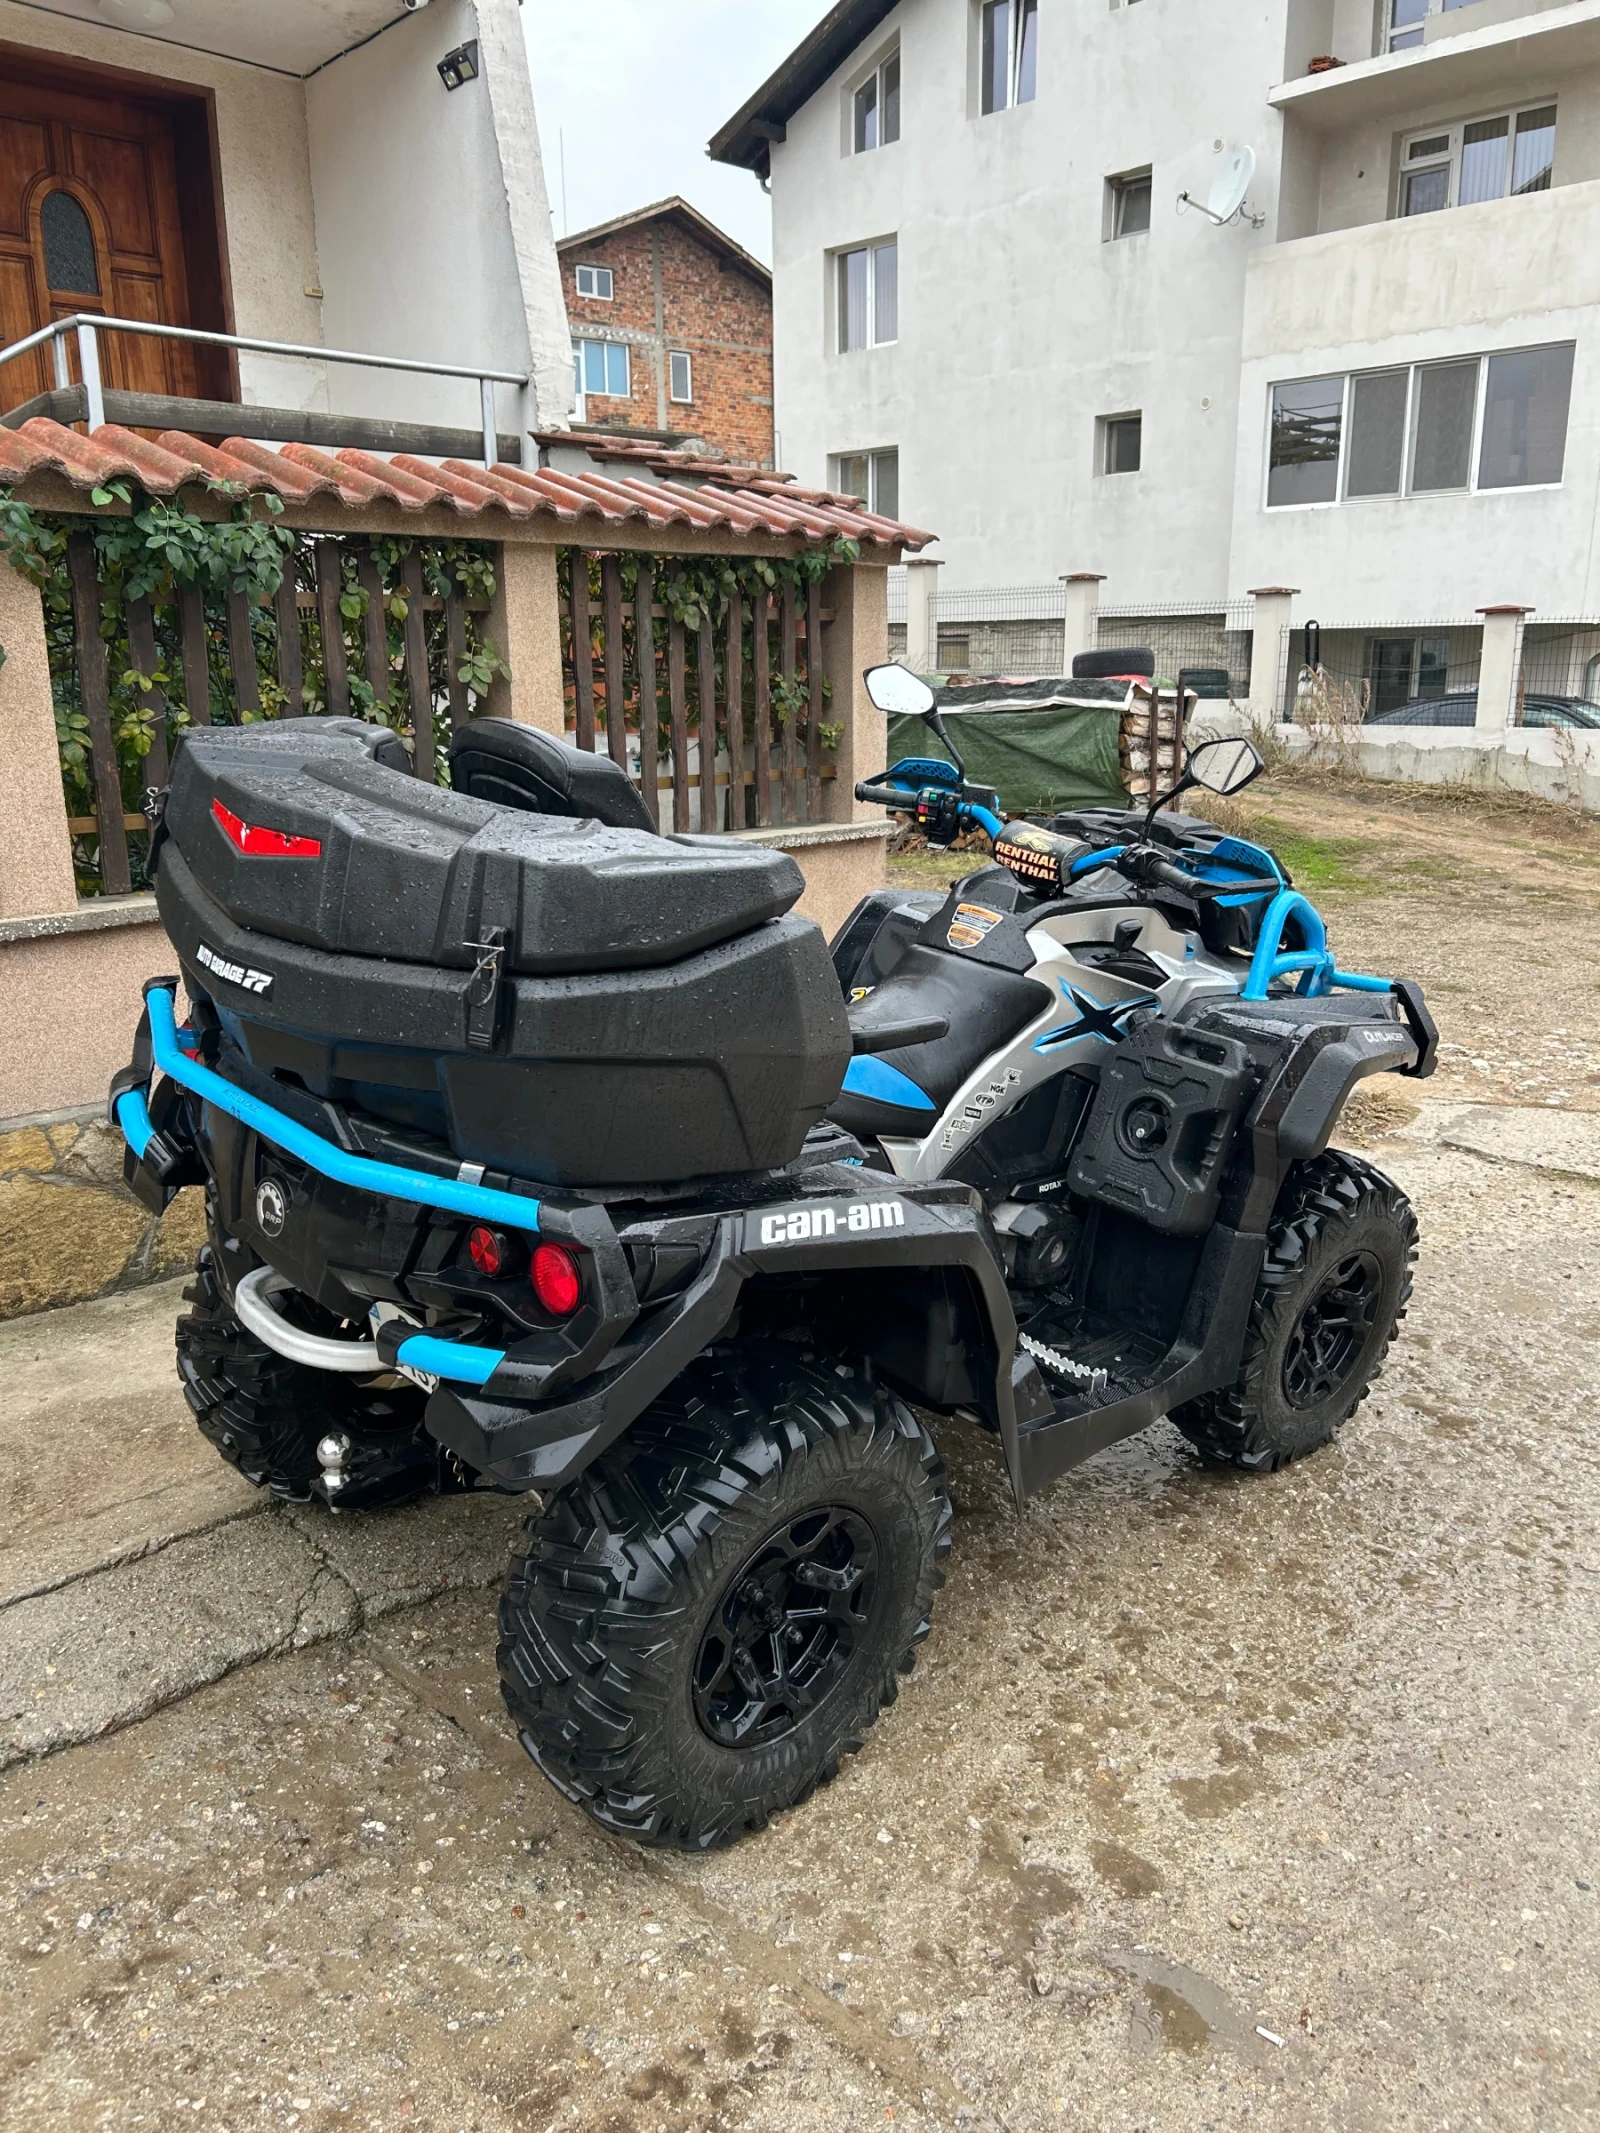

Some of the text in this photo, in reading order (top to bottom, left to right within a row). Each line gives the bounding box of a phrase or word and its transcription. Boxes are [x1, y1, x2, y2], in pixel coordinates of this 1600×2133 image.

[995, 841, 1058, 869] RENTHAL
[996, 854, 1058, 881] RENTHAL
[241, 968, 275, 994] 77
[990, 1084, 1005, 1094] NGK
[1039, 1180, 1062, 1193] ROTAX
[265, 1210, 282, 1225] BRP
[761, 1201, 905, 1244] can-am
